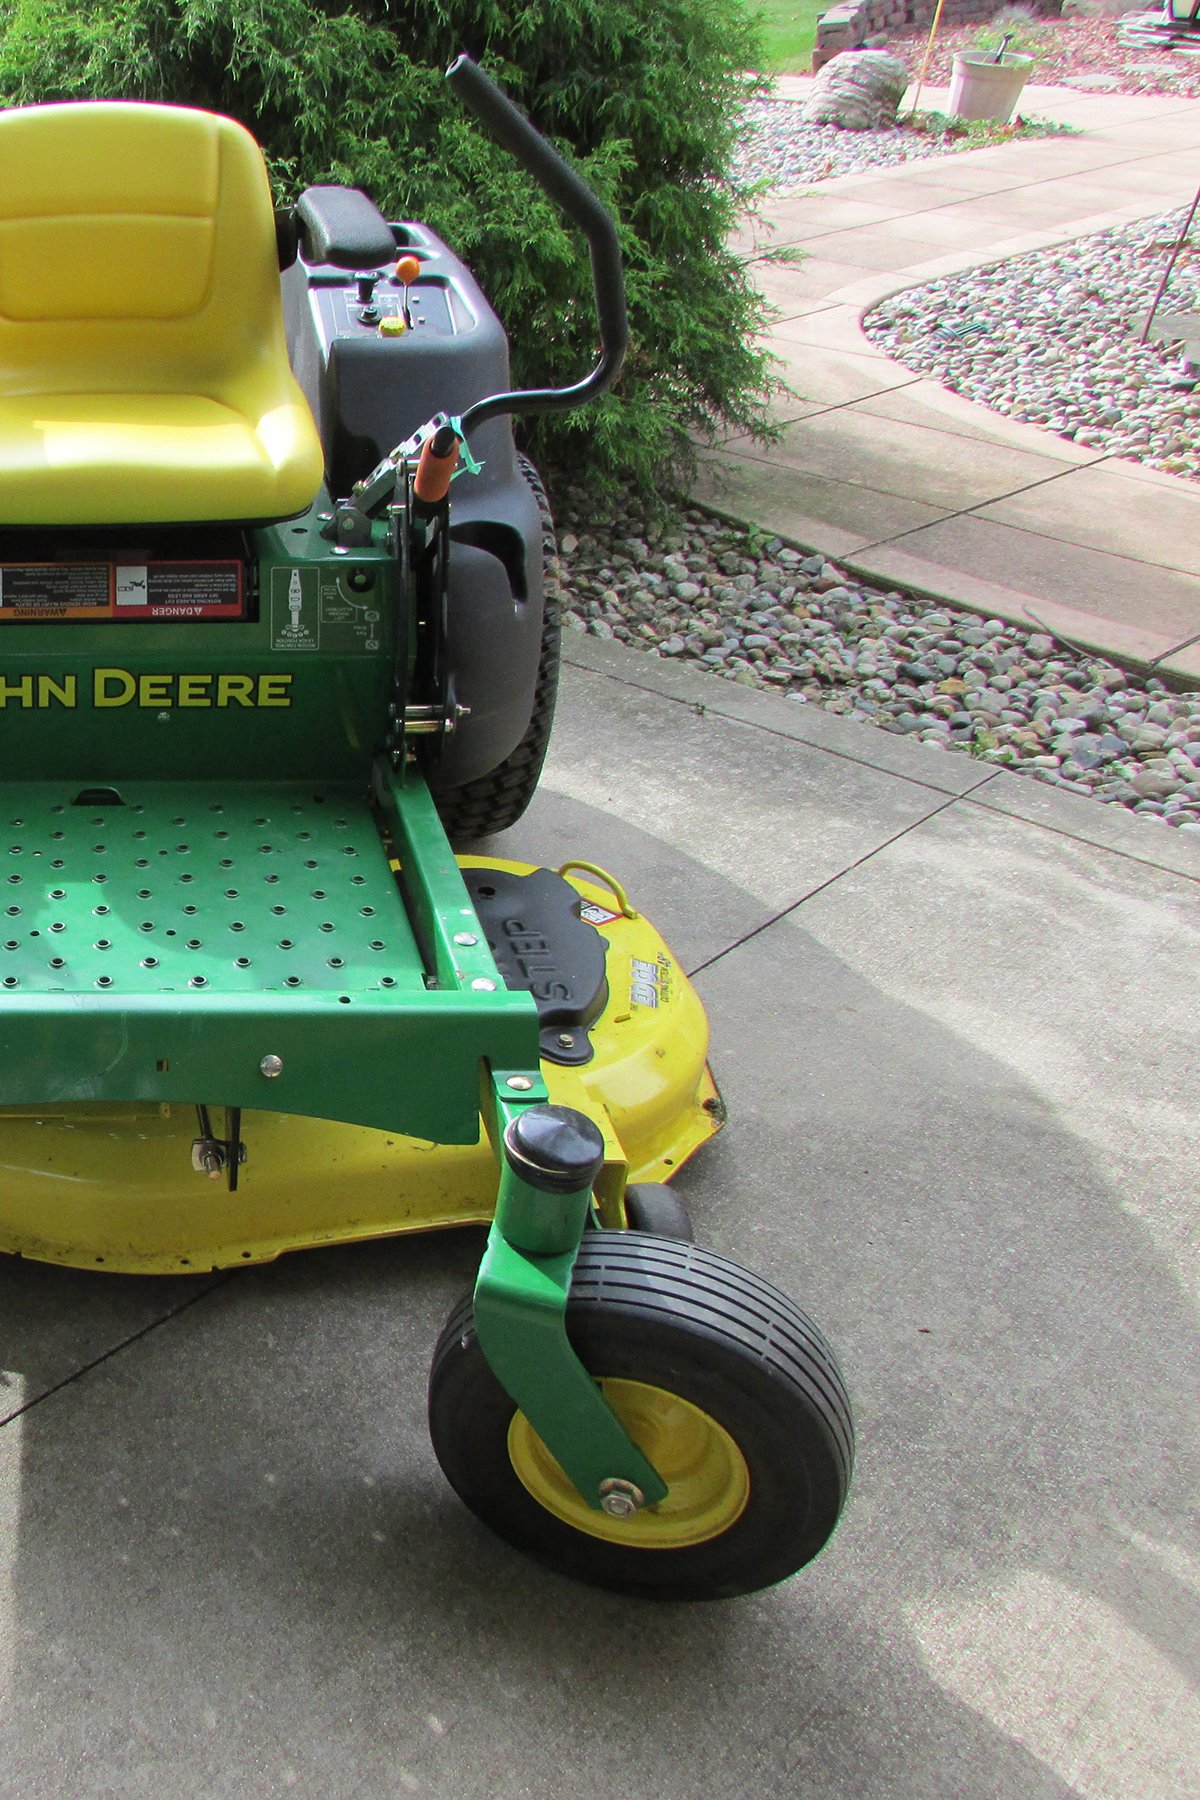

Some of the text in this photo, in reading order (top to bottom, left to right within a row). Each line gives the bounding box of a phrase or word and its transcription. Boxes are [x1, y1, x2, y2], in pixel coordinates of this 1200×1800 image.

[13, 608, 59, 617] WARNING
[152, 607, 193, 616] DANGER
[91, 667, 293, 709] DEERE
[502, 919, 571, 1003] STEP
[629, 957, 659, 1009] EDGE
